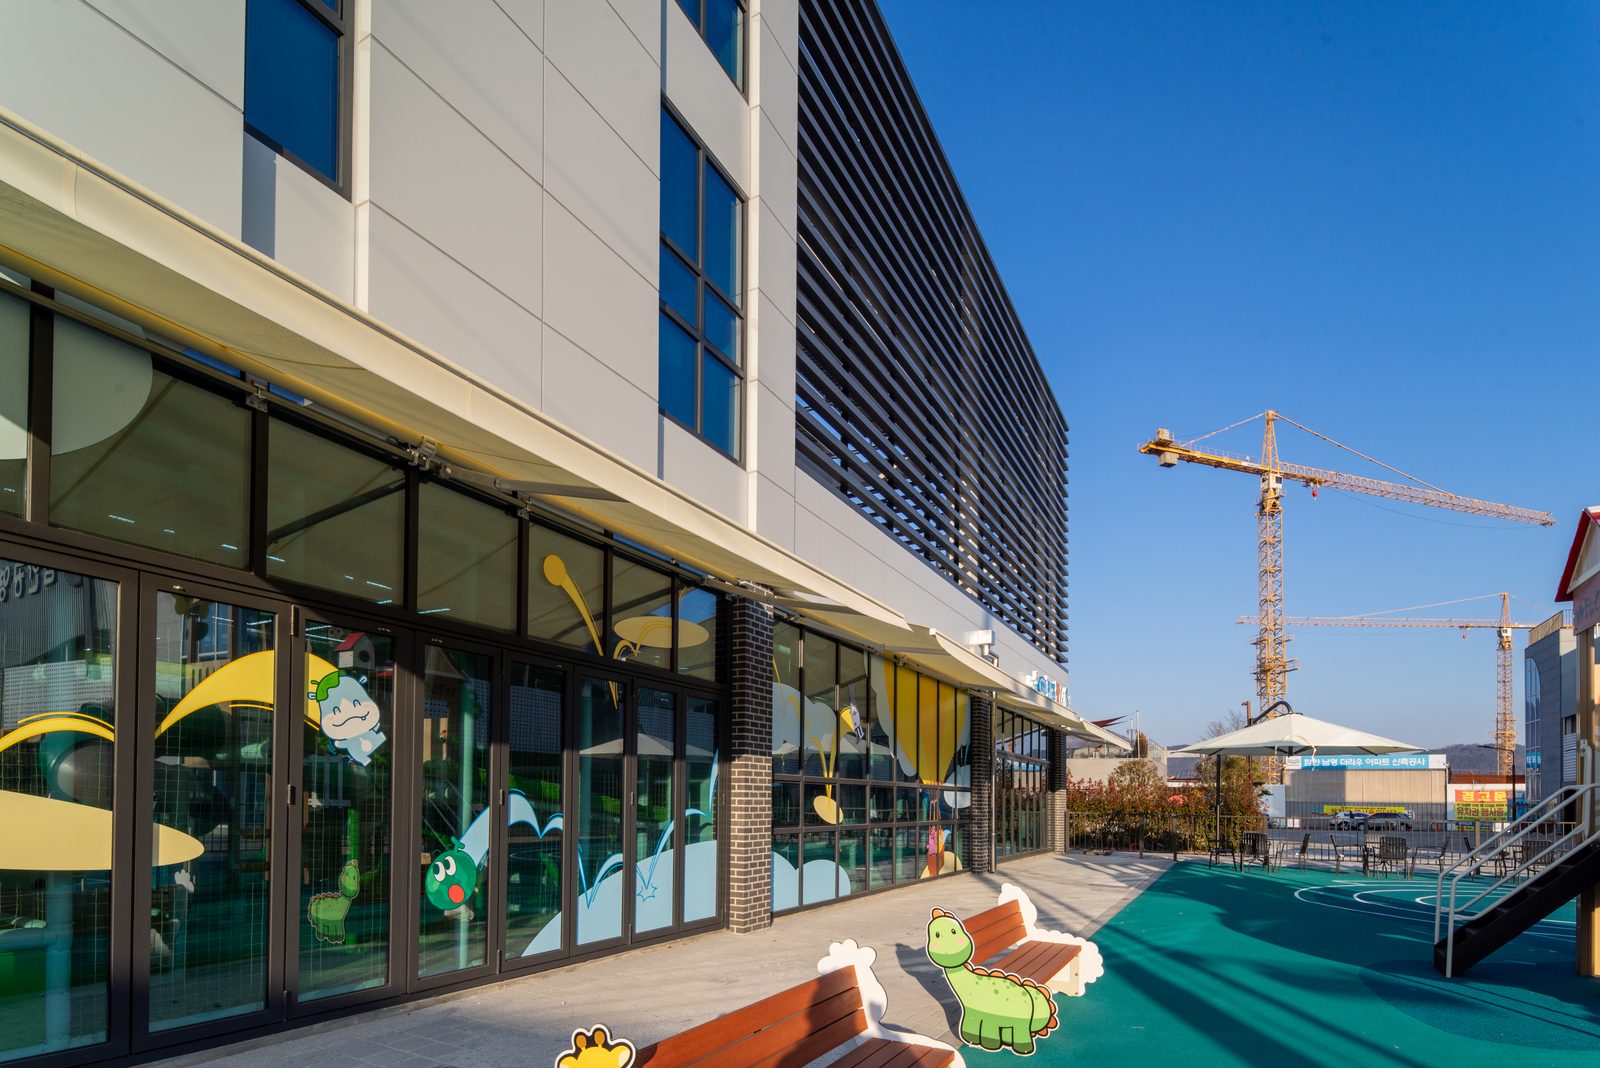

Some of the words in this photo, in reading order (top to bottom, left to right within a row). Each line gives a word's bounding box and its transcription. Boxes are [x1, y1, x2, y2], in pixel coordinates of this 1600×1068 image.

[1365, 758, 1390, 766] 아파트
[1392, 758, 1425, 766] 신축공사
[1462, 791, 1507, 802] 경고문
[1457, 807, 1479, 816] 유치권
[1481, 807, 1504, 817] 행사중
